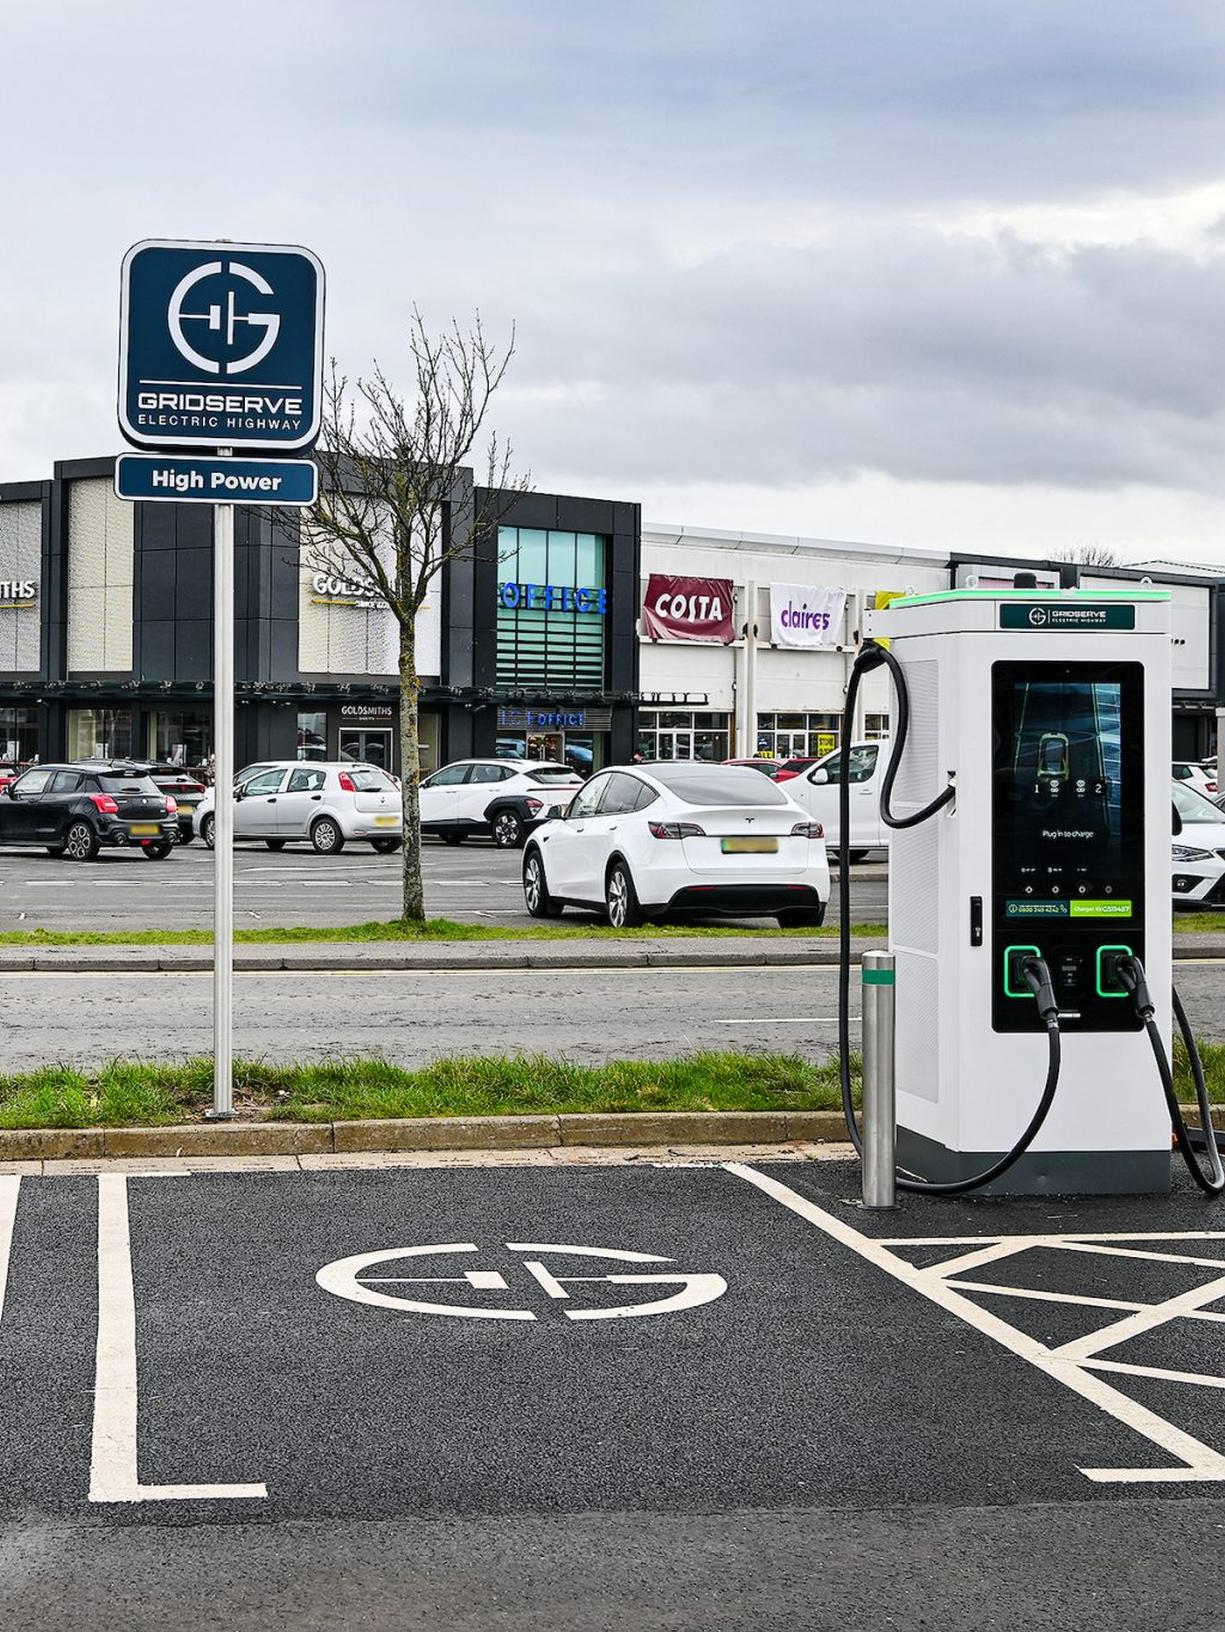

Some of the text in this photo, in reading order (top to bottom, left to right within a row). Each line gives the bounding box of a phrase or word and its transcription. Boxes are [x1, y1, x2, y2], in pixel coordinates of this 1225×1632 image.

[137, 392, 303, 416] GRIDSERVE
[137, 414, 302, 431] ELECTRIC HIGHWAY
[151, 469, 282, 492] High Power
[502, 581, 608, 615] OFFICE
[654, 592, 723, 625] COSTA
[780, 600, 831, 631] claires
[1051, 610, 1107, 618] GRIDSERVE
[340, 705, 393, 716] GOLDSMITHS
